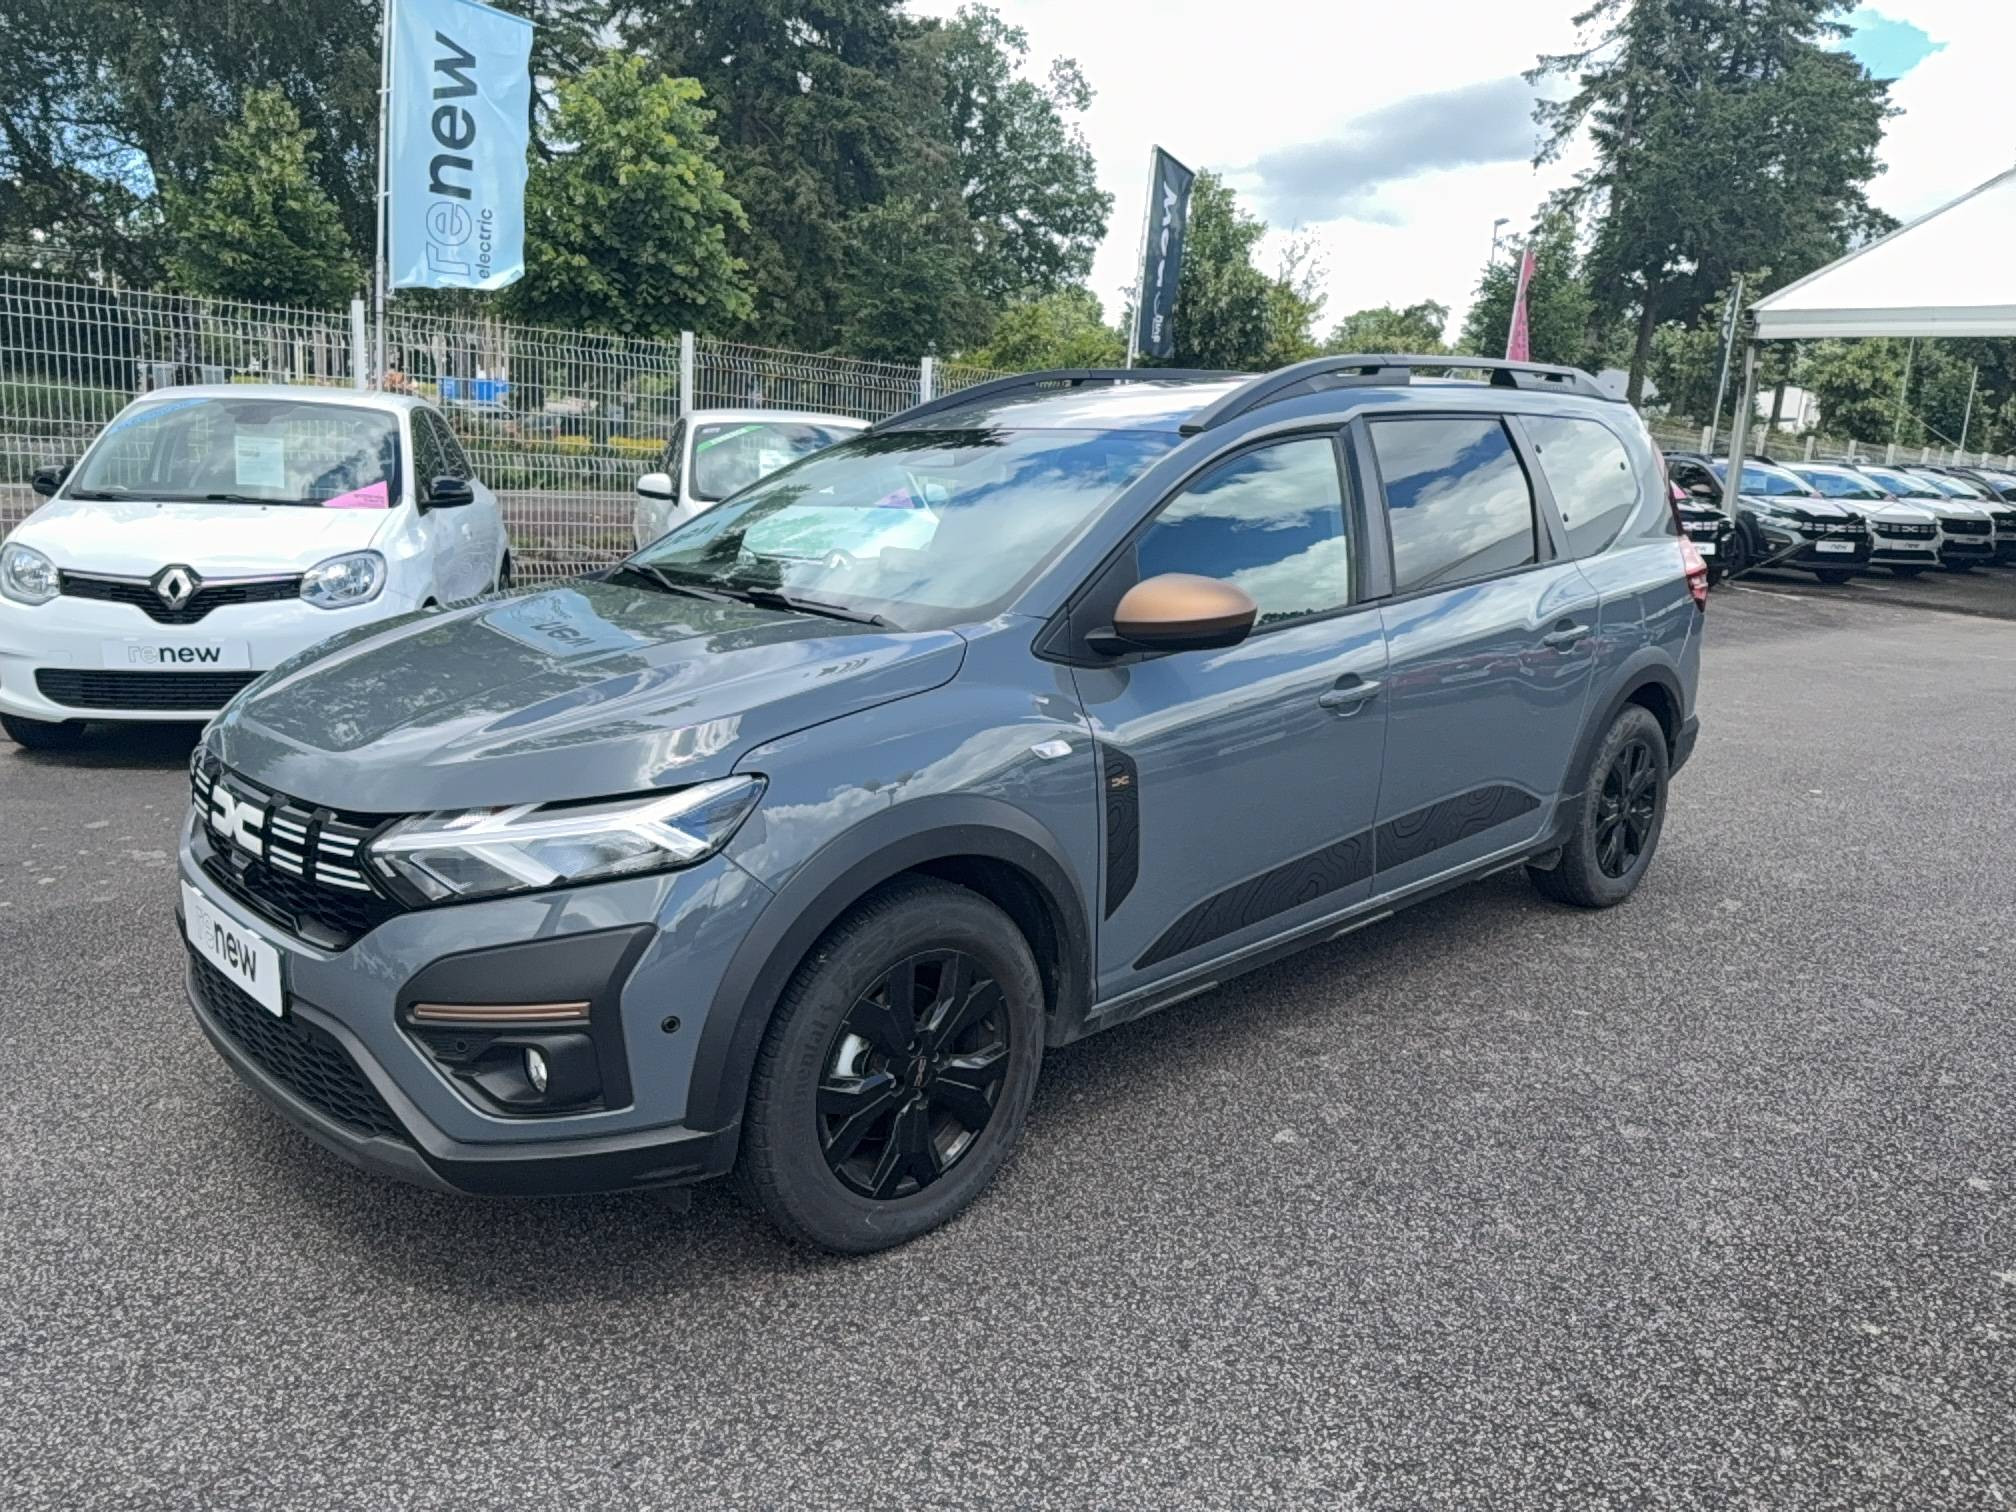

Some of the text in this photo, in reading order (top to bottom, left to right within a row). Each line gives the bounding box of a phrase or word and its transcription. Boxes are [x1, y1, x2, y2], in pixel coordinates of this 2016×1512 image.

[426, 30, 478, 276] renew
[474, 207, 493, 279] electric
[127, 645, 221, 664] renew
[196, 904, 257, 982] renew
